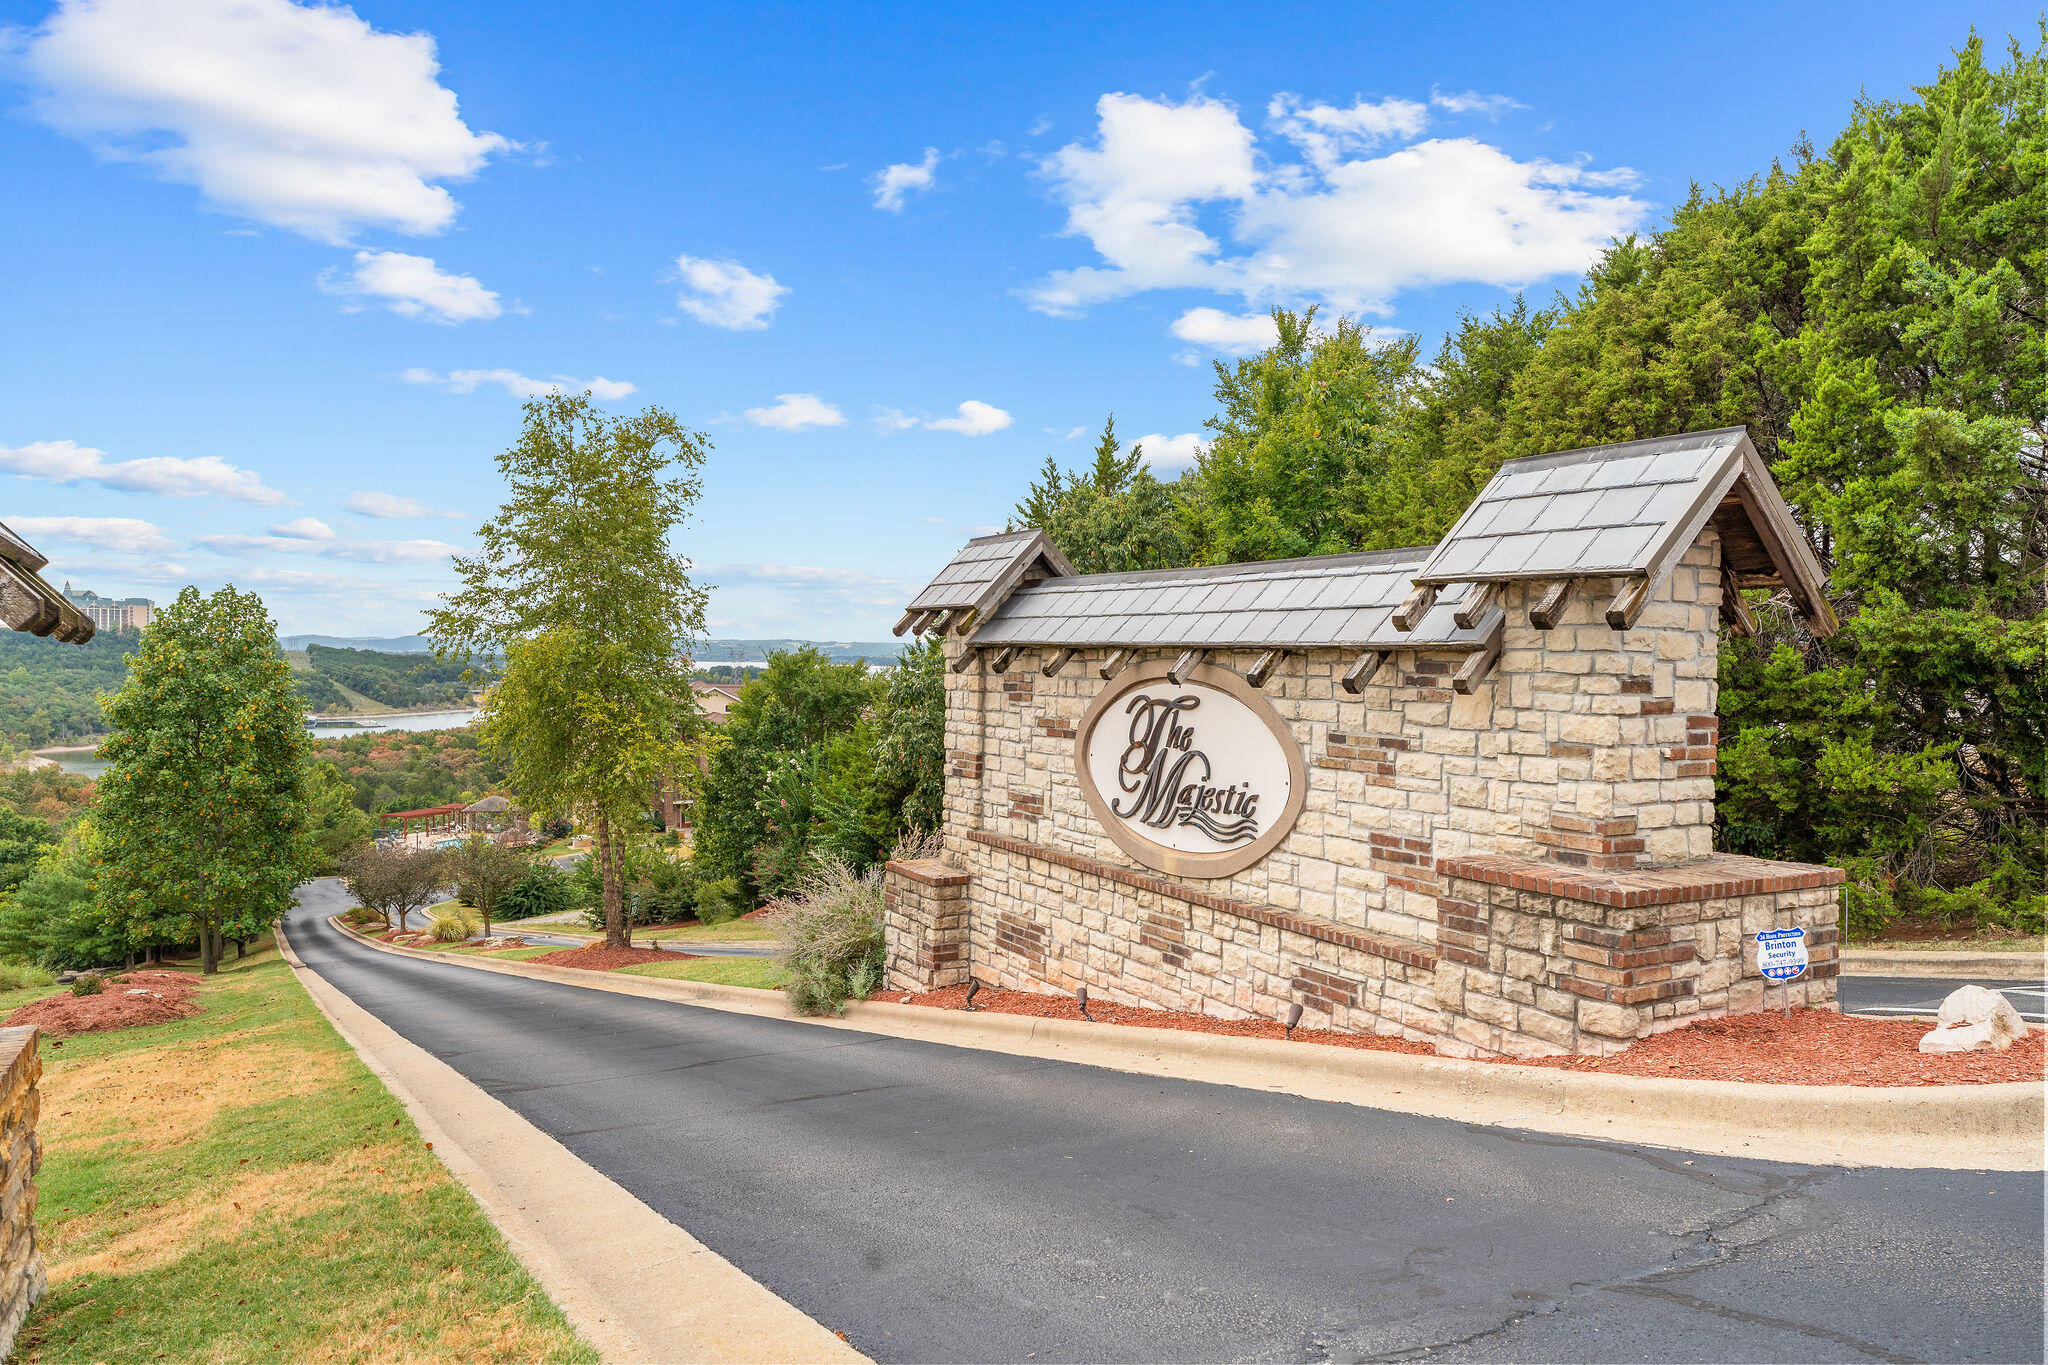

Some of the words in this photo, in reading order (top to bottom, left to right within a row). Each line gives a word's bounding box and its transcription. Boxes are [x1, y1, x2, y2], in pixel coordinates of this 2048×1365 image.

[1118, 694, 1200, 792] The
[1111, 747, 1260, 829] Majestic
[1765, 940, 1796, 950] Brinton
[1768, 950, 1795, 958] Security
